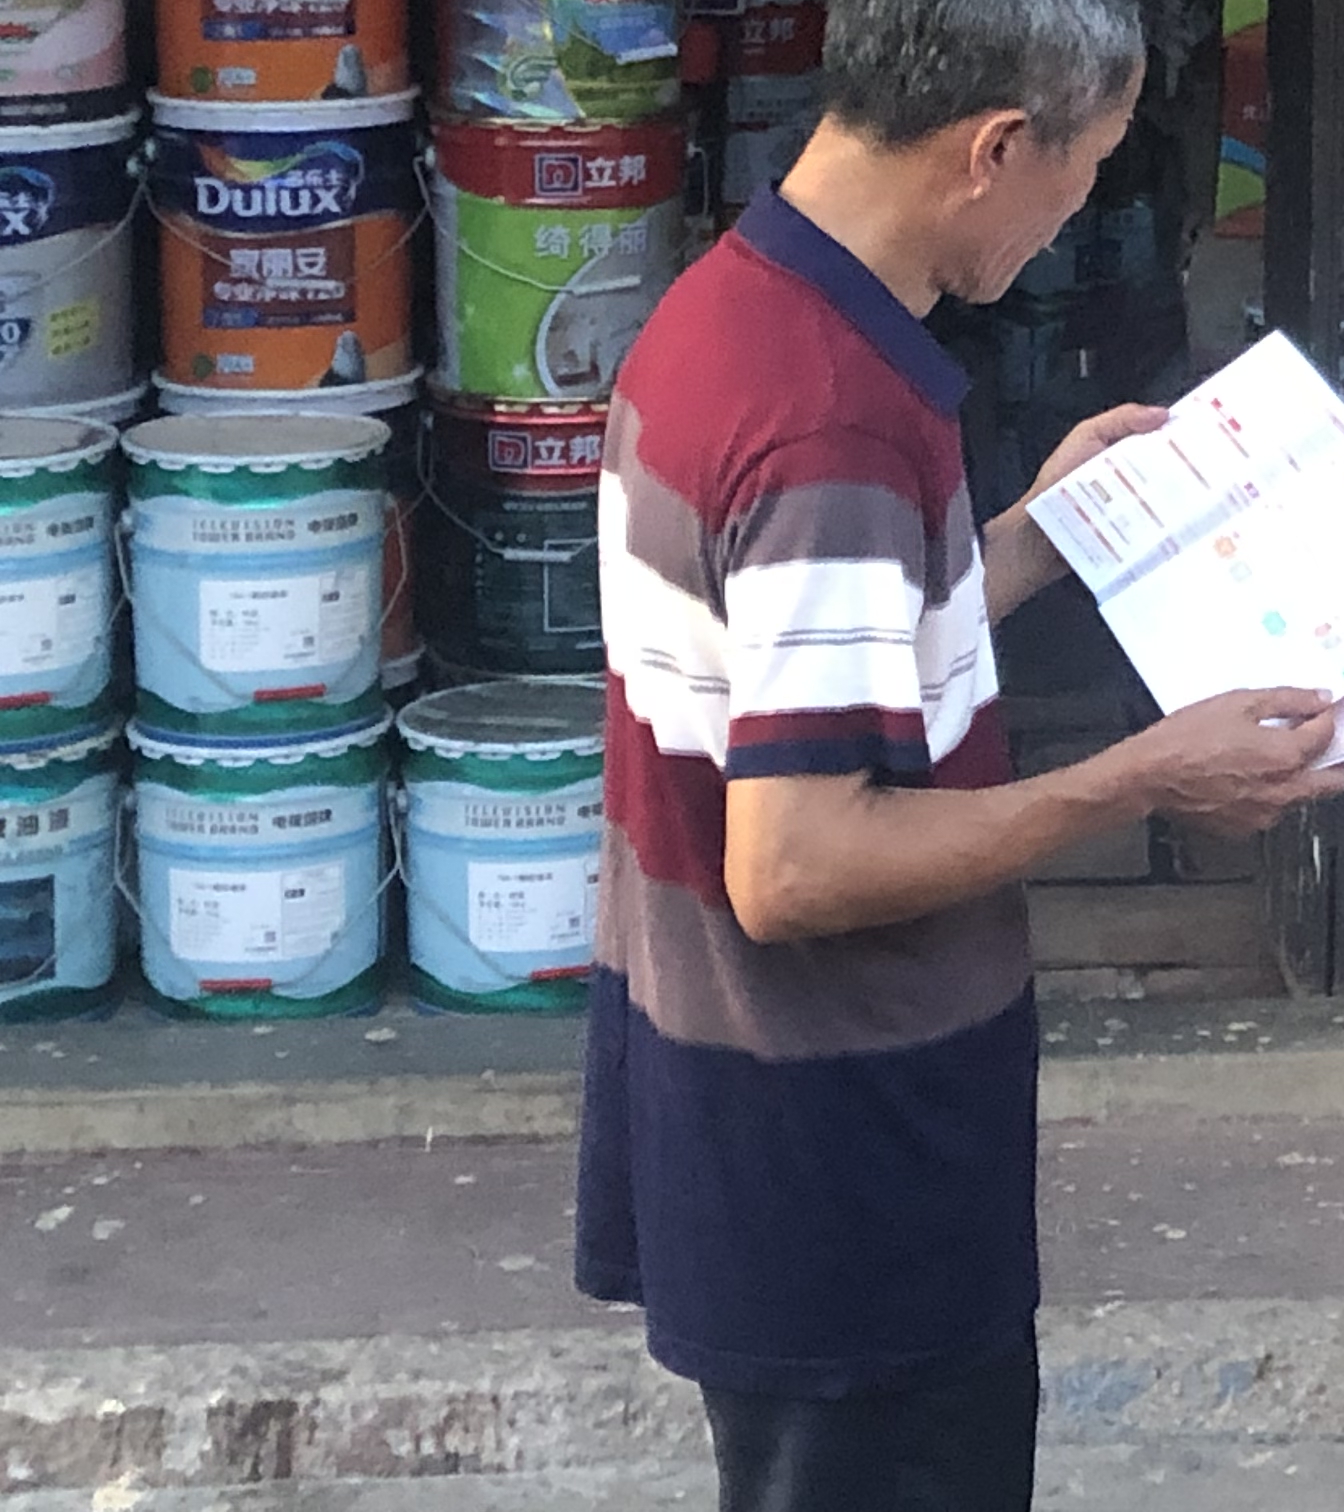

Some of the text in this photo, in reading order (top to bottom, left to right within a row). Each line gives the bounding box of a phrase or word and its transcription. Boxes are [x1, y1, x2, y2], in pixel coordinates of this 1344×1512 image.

[585, 154, 646, 187] 立邦
[193, 177, 342, 217] Dulux
[534, 223, 647, 259] 绮得丽
[534, 435, 600, 466] 立邦
